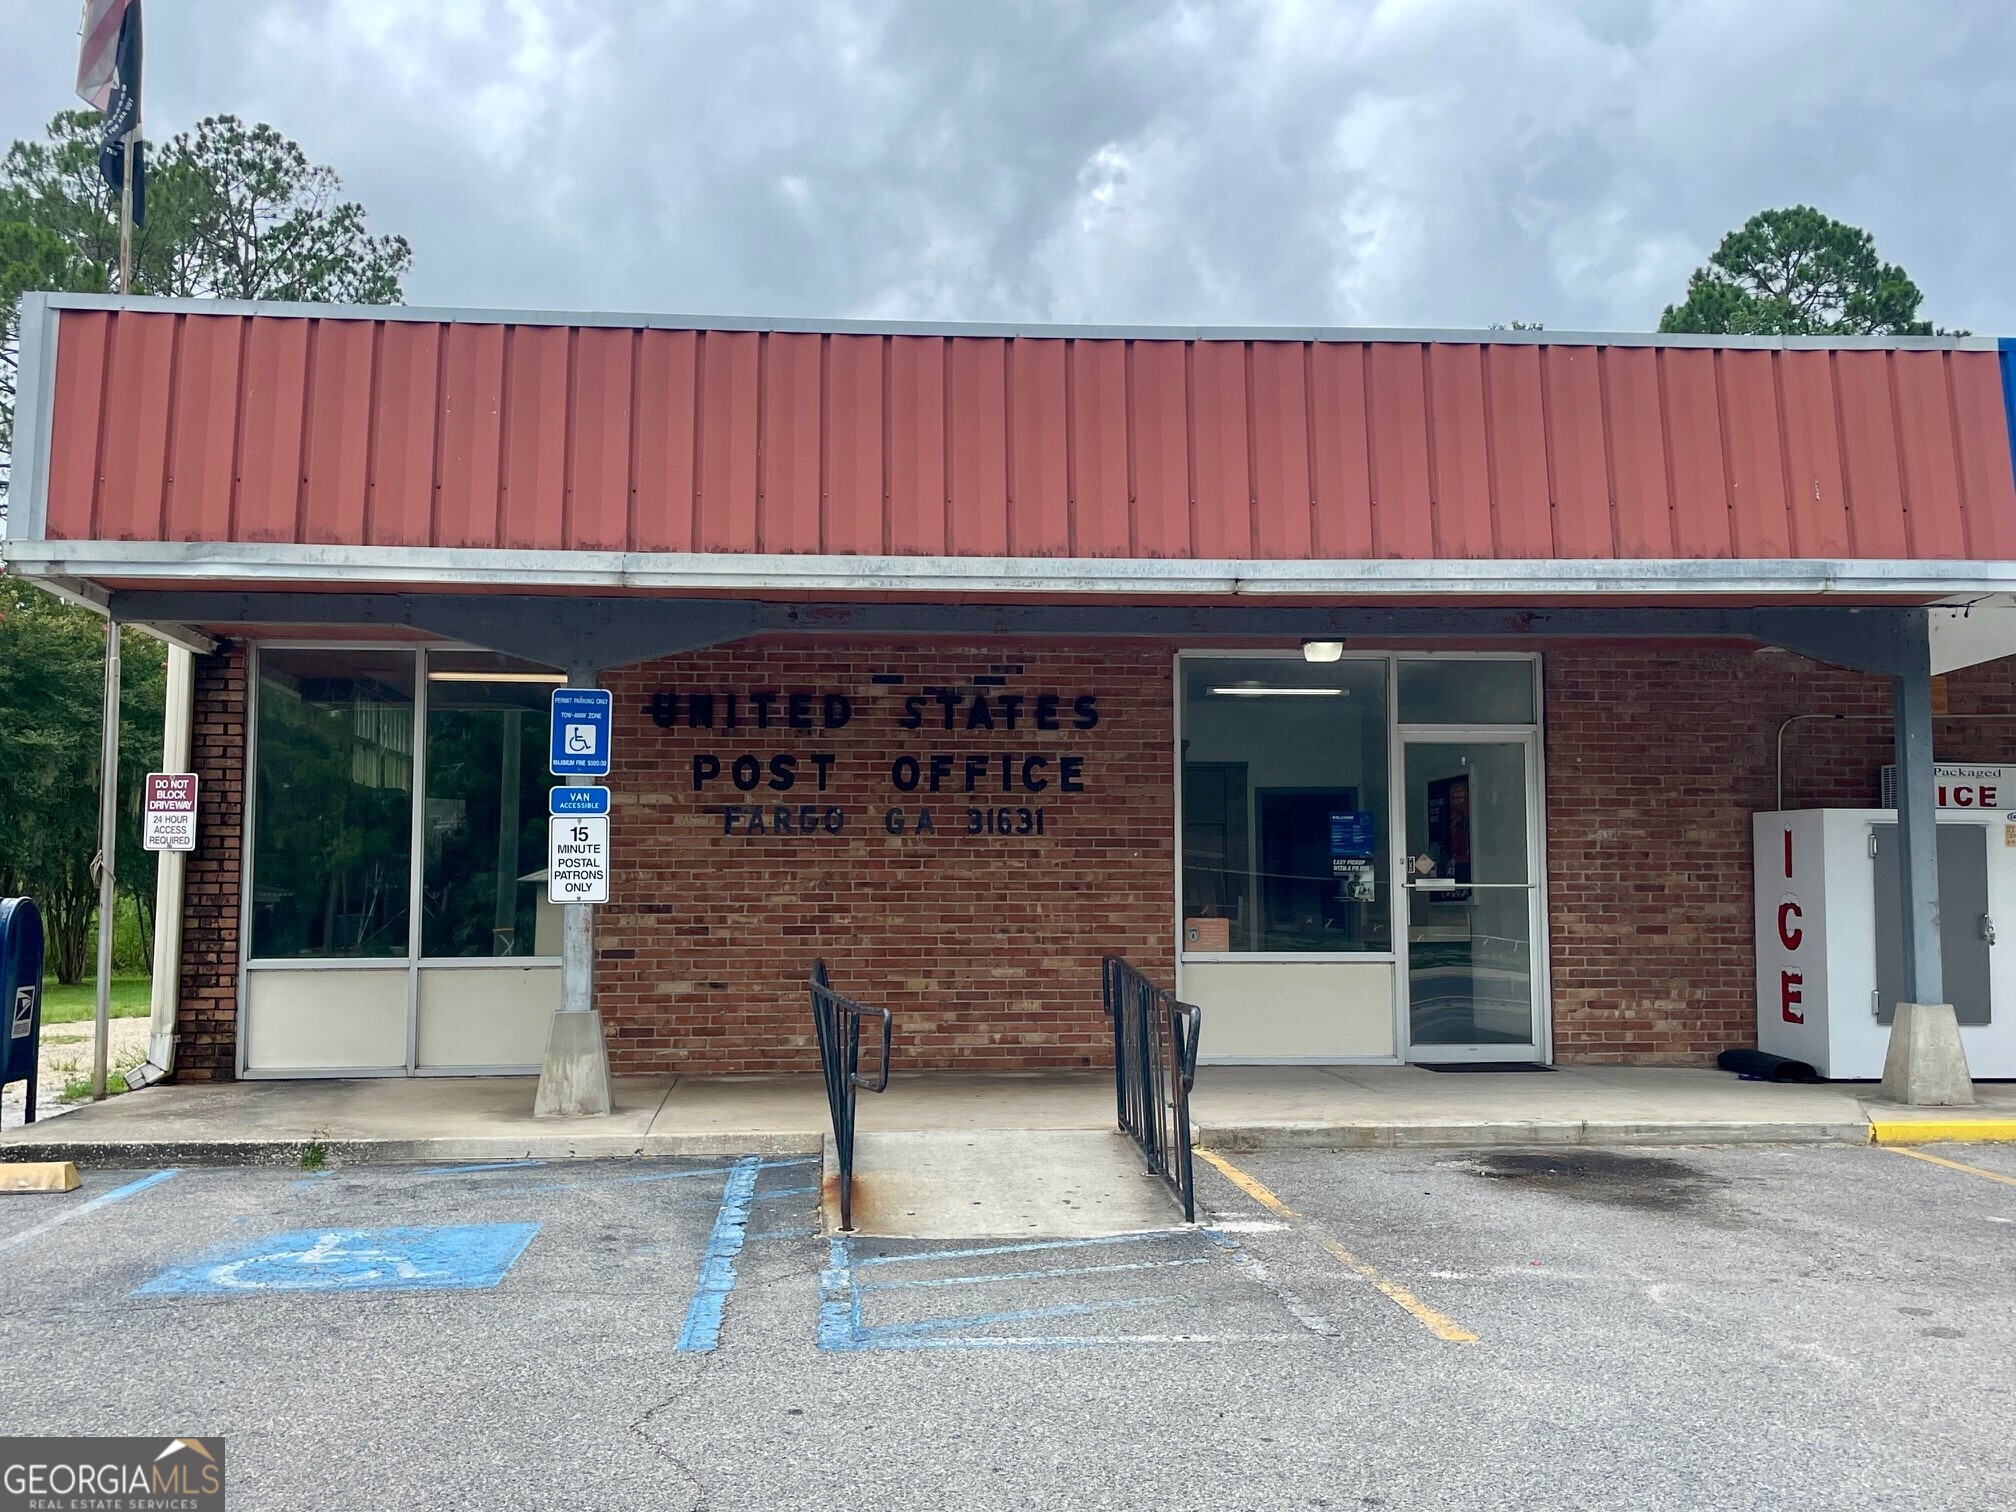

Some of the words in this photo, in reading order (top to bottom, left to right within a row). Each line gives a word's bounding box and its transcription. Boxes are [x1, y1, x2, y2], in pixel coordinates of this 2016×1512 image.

[651, 693, 852, 729] UNITED
[900, 695, 1099, 730] STATES
[693, 754, 836, 791] POST
[891, 755, 1084, 792] OFFICE
[1933, 768, 2001, 779] Packaged
[155, 780, 168, 789] DO
[171, 780, 189, 789] NOT
[157, 790, 186, 799] BLOCK
[570, 793, 590, 801] VAN
[1938, 786, 1997, 807] ICE
[150, 801, 192, 810] DRIVEWAY
[154, 816, 163, 824] 24
[165, 816, 188, 824] HOUR
[724, 805, 845, 836] FARGO
[885, 807, 936, 835] GA
[965, 807, 1044, 835] 31631
[154, 826, 187, 834] ACCESS
[571, 827, 589, 842] 15
[150, 837, 190, 845] REQUIRED
[558, 845, 601, 854] MINUTE
[558, 859, 600, 868] POSTAL
[555, 871, 604, 880] PATRONS
[566, 883, 593, 892] ONLY
[1778, 822, 1804, 1024] ICE
